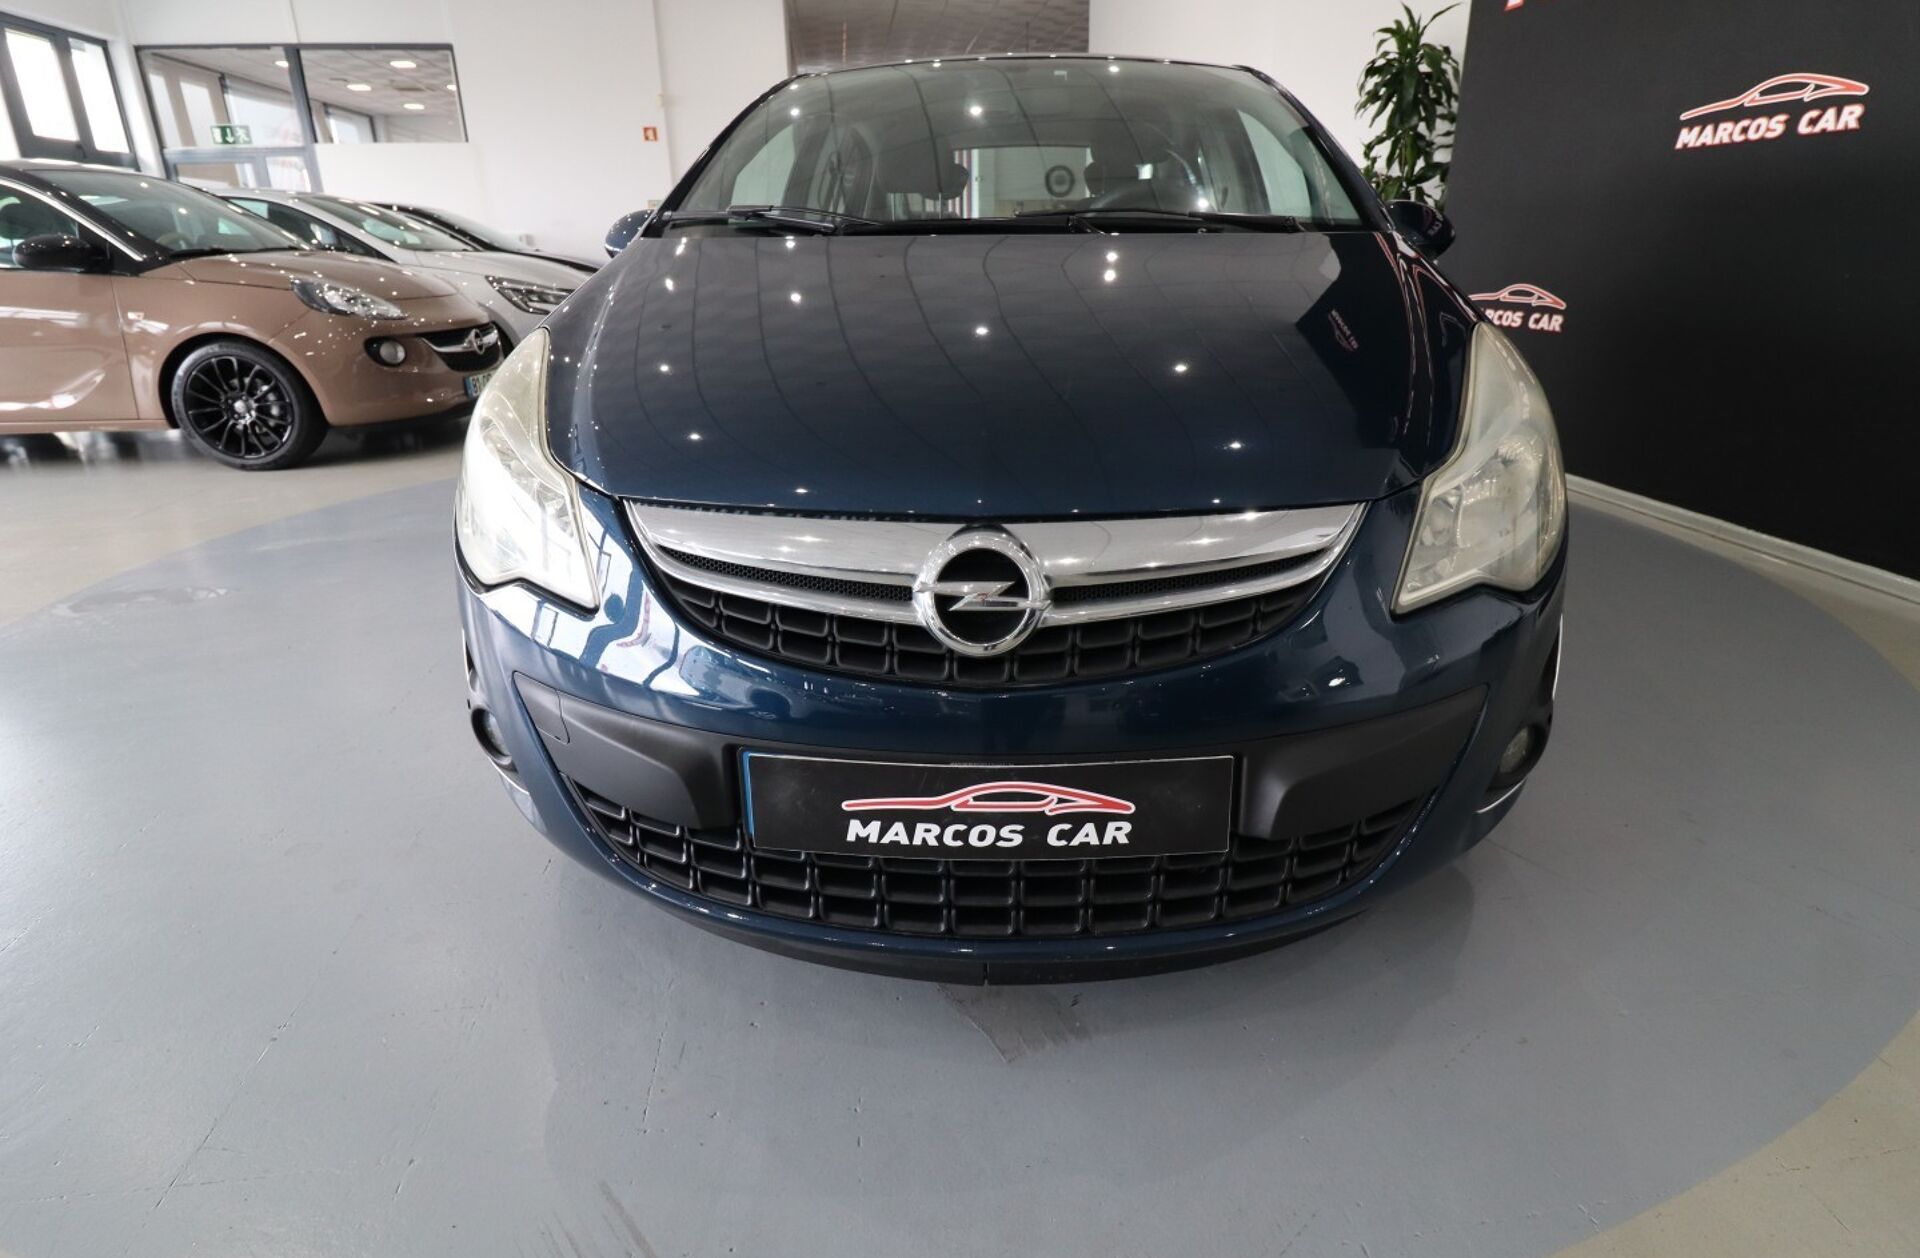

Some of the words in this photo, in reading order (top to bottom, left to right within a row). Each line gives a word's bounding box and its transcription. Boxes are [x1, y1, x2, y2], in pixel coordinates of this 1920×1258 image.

[1674, 113, 1790, 149] MARCOS
[1797, 103, 1865, 135] CAR
[1528, 312, 1564, 332] CAR
[846, 819, 1025, 848] MARCOS
[1046, 821, 1133, 847] CAR
